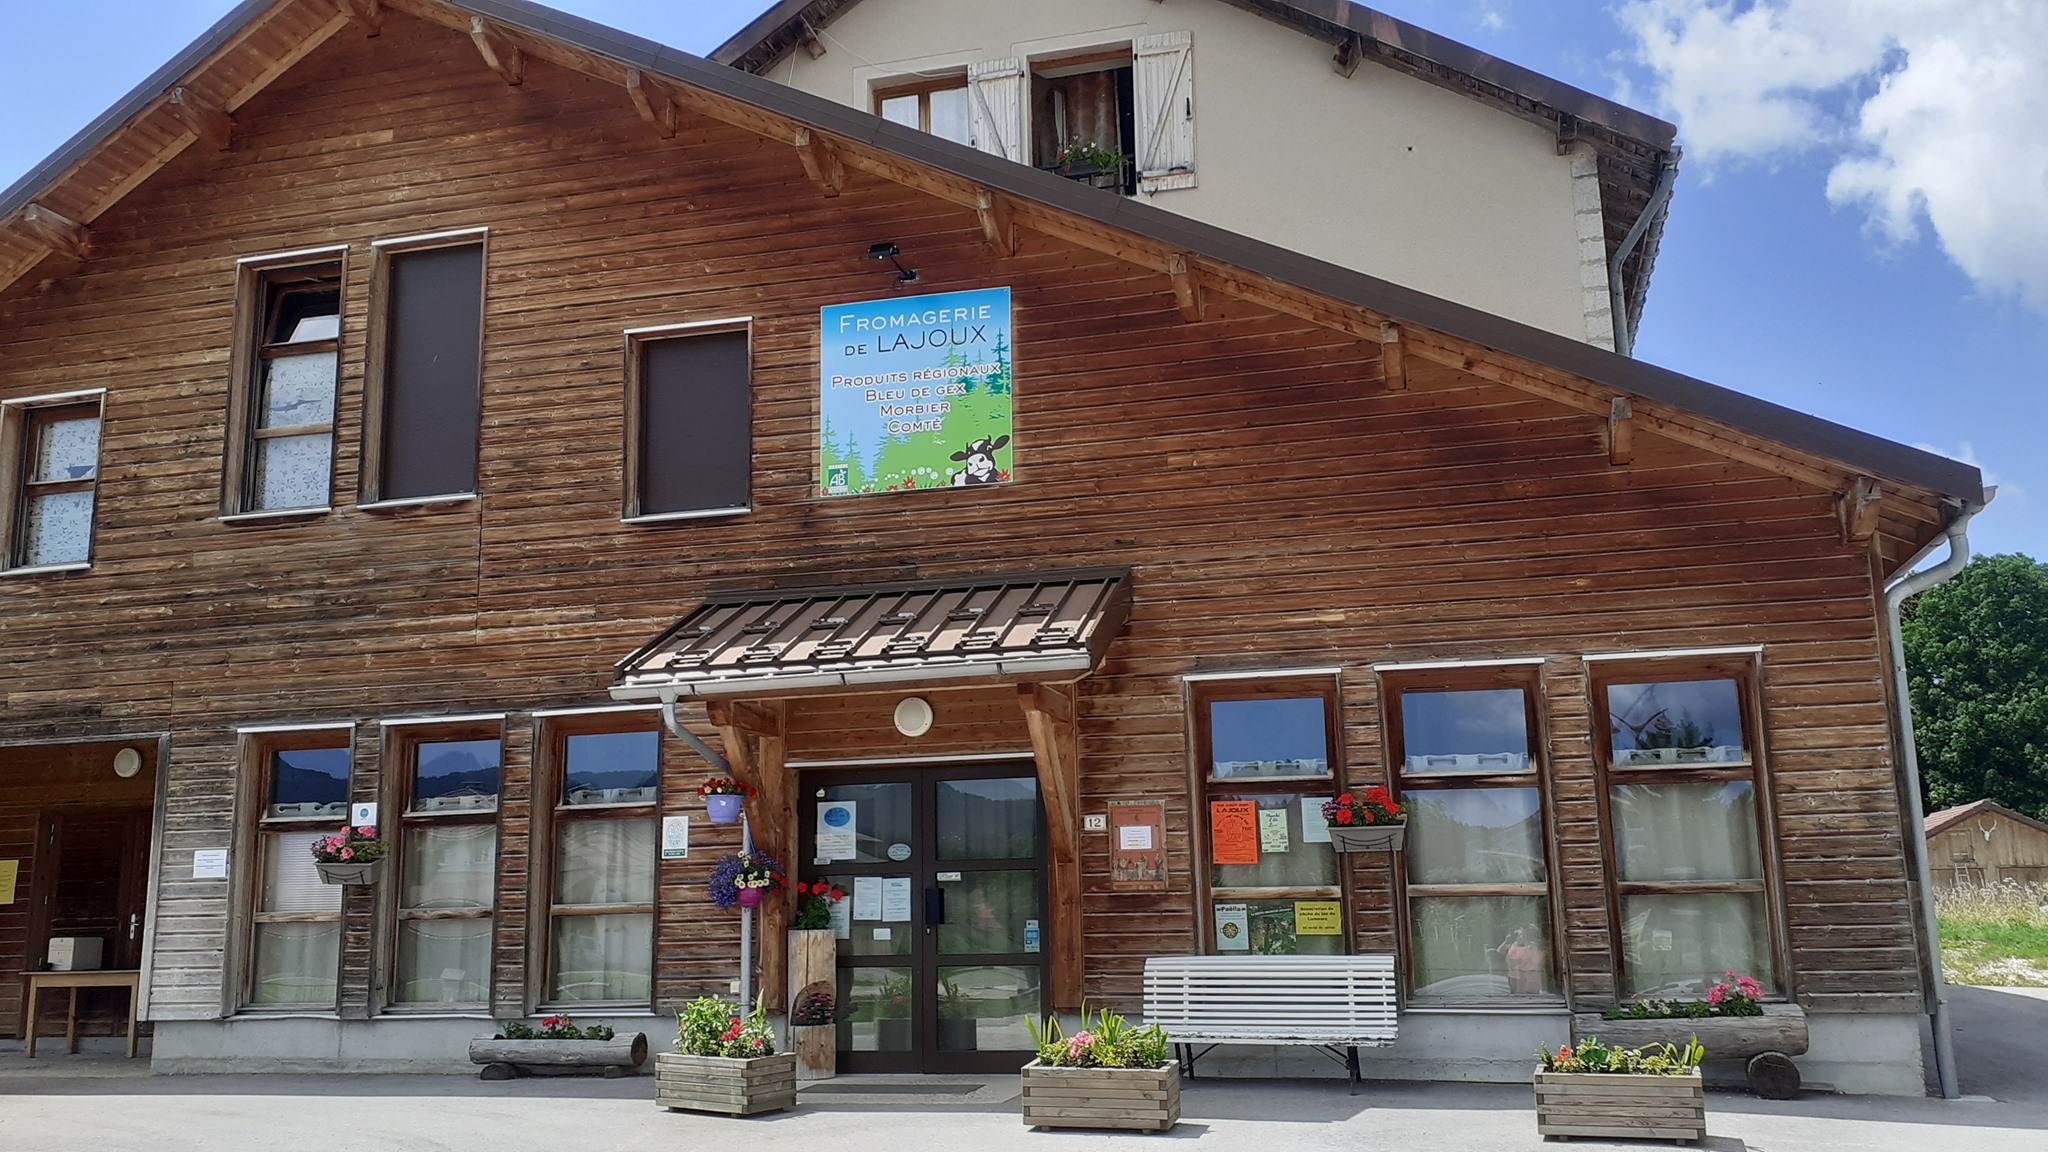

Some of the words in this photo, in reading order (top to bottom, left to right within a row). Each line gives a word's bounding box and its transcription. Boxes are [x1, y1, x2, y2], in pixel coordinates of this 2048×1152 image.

[840, 305, 991, 333] FROMAGERIE
[845, 344, 867, 356] DE
[878, 324, 987, 353] LAJOUX
[832, 374, 908, 388] PRODUITS
[913, 363, 1000, 380] RÉGIONAUX
[866, 389, 905, 402] BLEU
[911, 387, 930, 398] DE
[936, 384, 966, 395] GEX
[880, 402, 950, 417] MORBIER
[888, 419, 942, 433] COMTÉ
[830, 473, 846, 487] AB
[1089, 818, 1101, 827] 12
